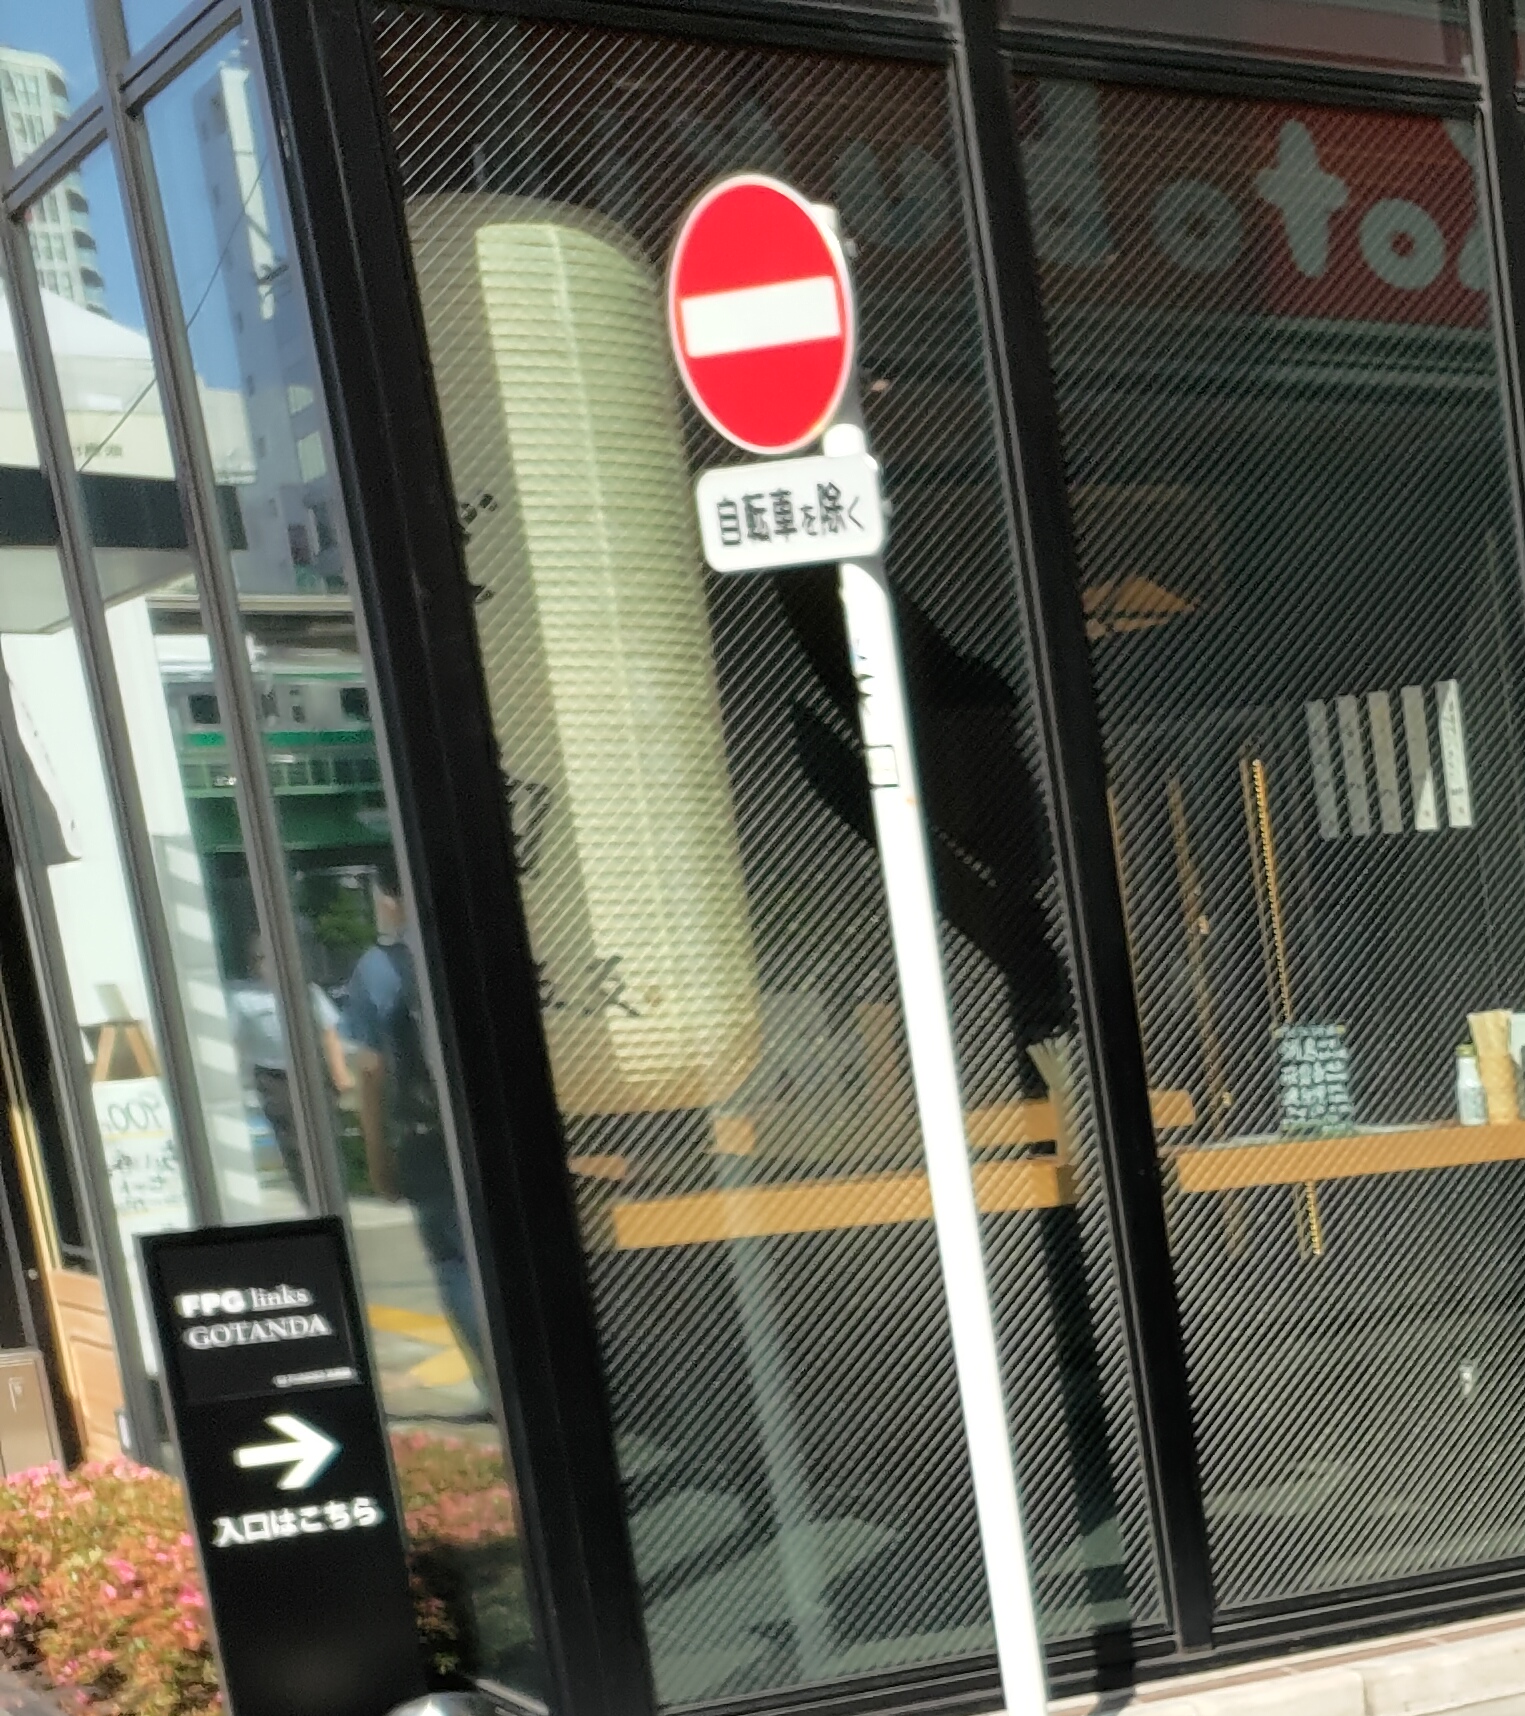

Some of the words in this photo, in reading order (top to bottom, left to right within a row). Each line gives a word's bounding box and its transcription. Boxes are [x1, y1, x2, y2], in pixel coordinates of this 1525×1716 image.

[717, 482, 866, 546] 自転車を除く
[180, 1288, 246, 1319] FPG
[250, 1284, 314, 1311] links
[184, 1313, 334, 1350] GOTANDA
[212, 1497, 385, 1547] 入口はこちら
